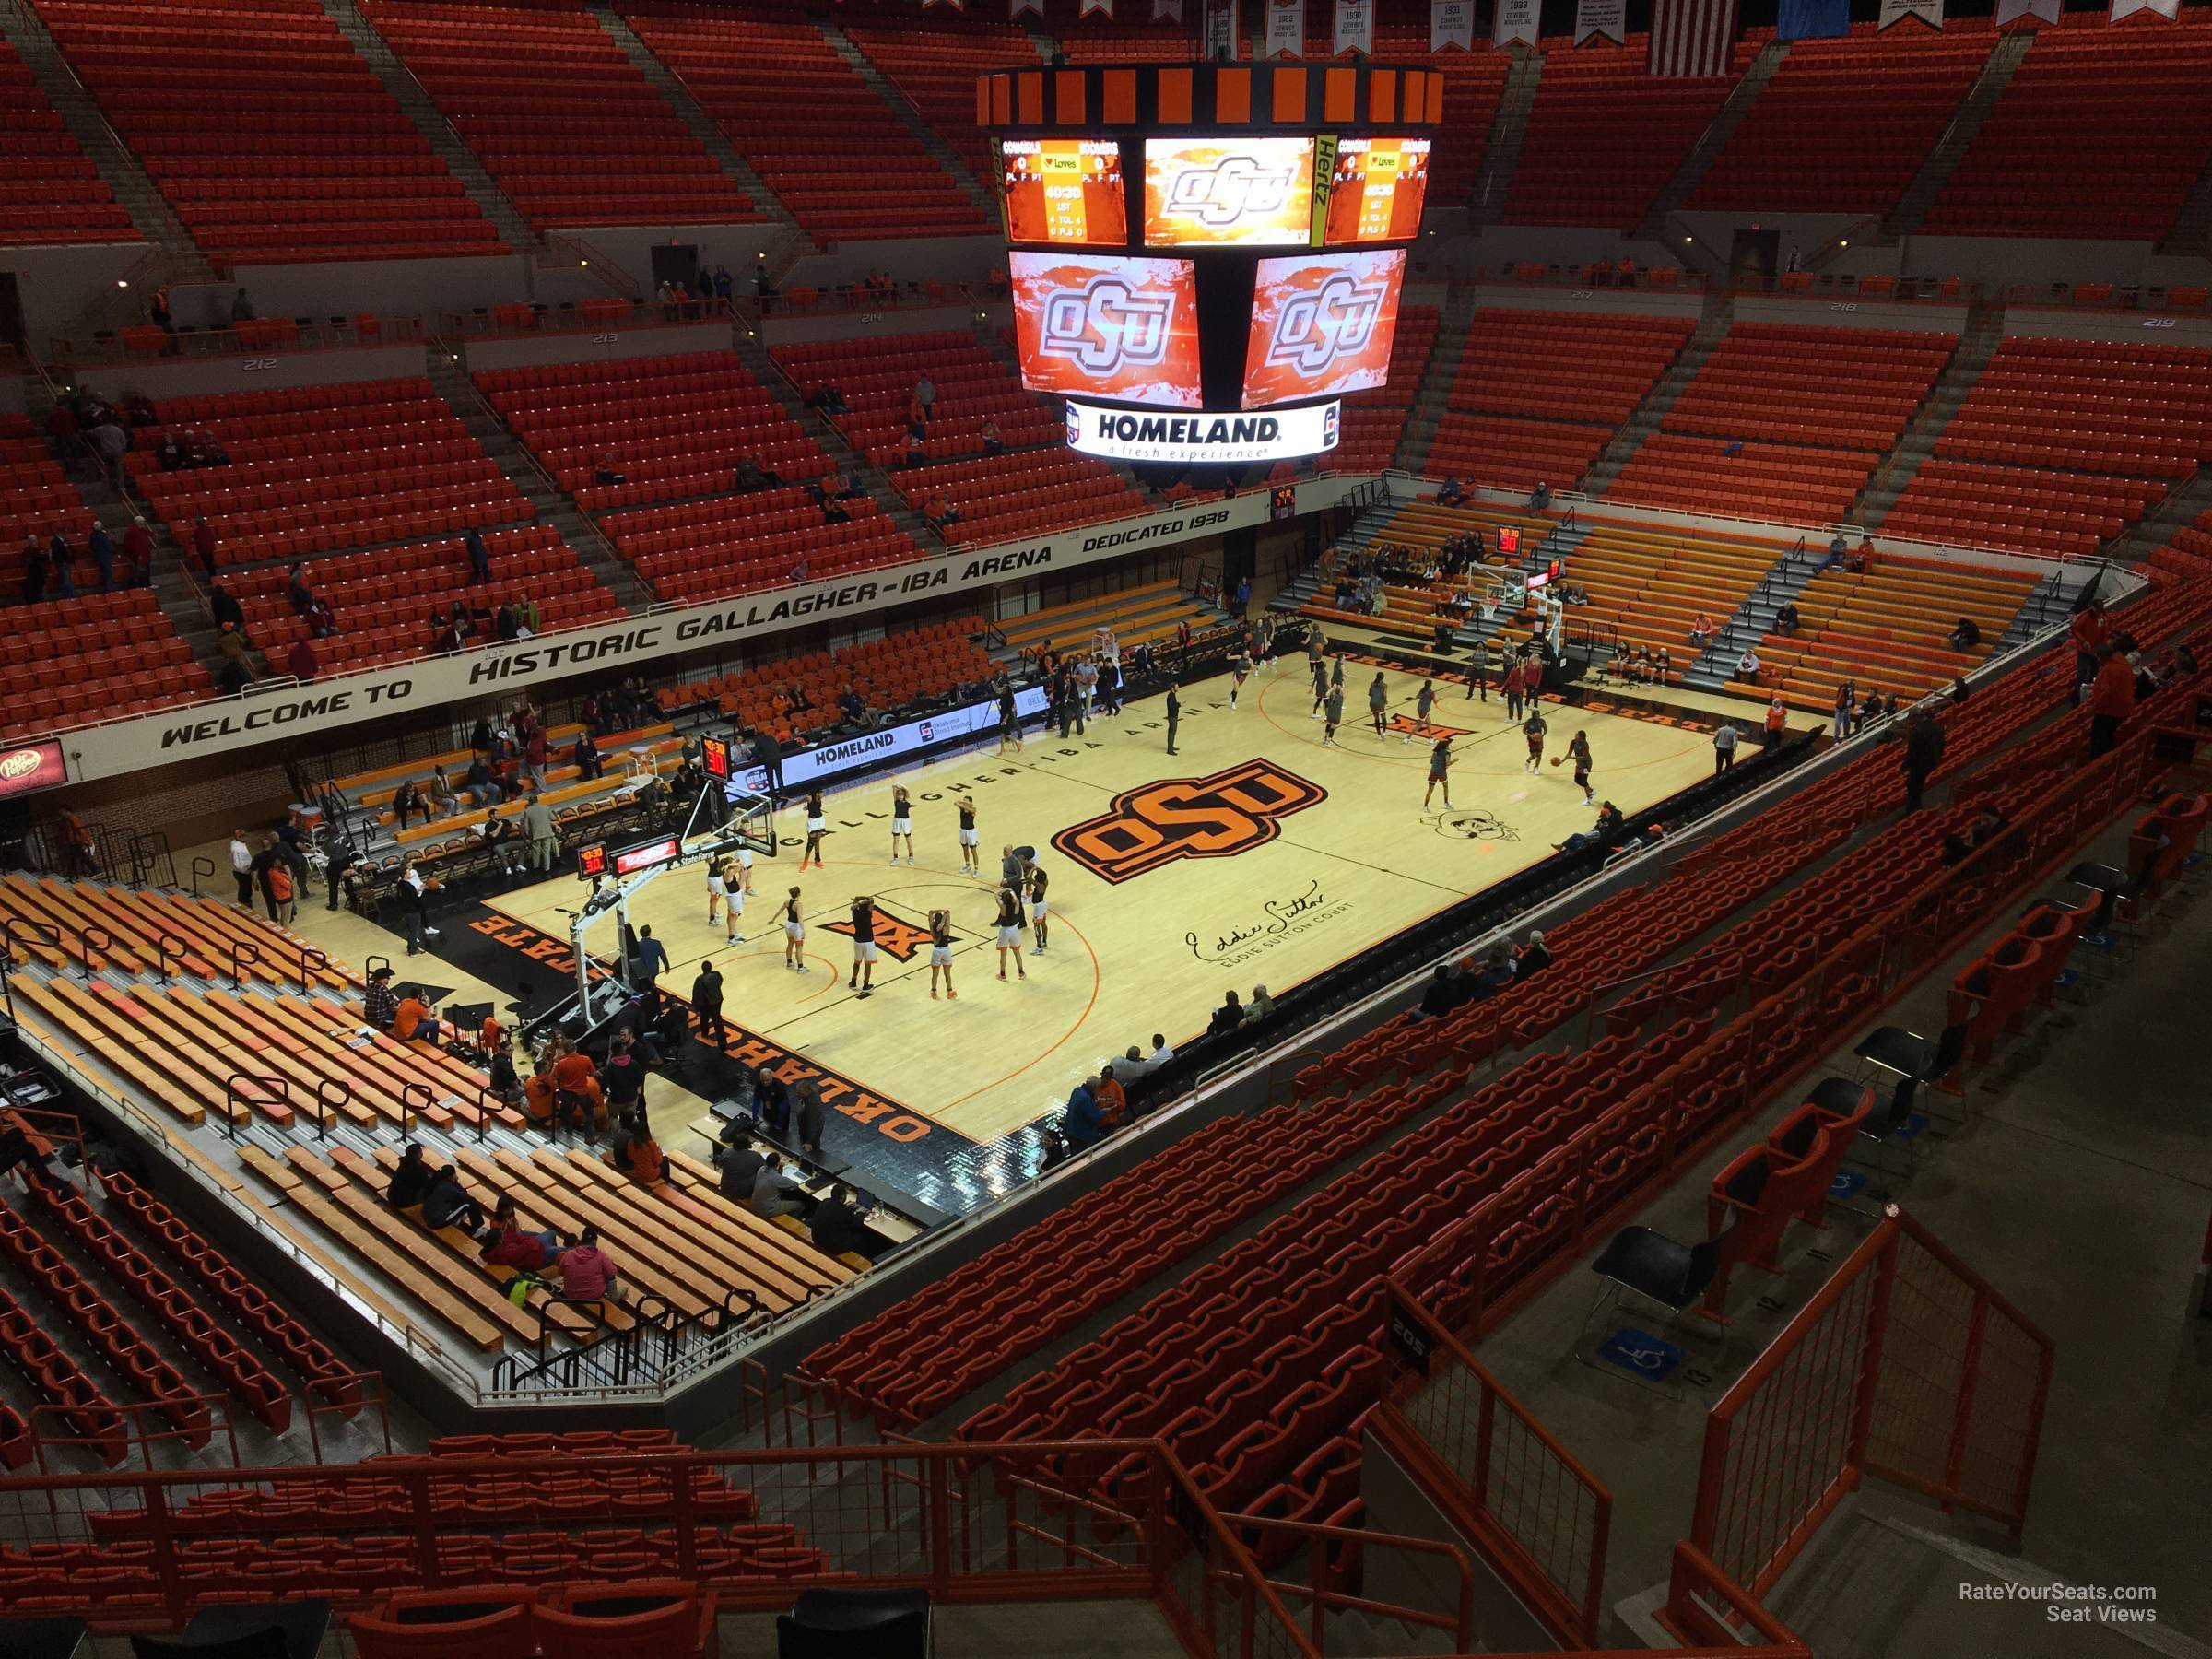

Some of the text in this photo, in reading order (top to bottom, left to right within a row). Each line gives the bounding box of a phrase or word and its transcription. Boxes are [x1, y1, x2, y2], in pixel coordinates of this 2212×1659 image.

[1506, 11, 1530, 19] COWBOY
[1510, 1, 1528, 10] 1933
[1020, 172, 1027, 182] F
[1031, 173, 1042, 182] PT
[1097, 173, 1103, 182] F
[1315, 139, 1335, 206] Hertz
[1160, 156, 1298, 227] OSU
[861, 313, 883, 323] 214
[1039, 275, 1177, 378] OSU
[1264, 272, 1389, 377] OSU
[2143, 317, 2176, 328] 219
[592, 332, 619, 345] 213
[242, 359, 277, 371] 212
[1122, 446, 1159, 458] fresh
[1500, 536, 1516, 553] 30
[161, 690, 353, 749] WELCOME
[364, 679, 413, 704] TO
[468, 626, 662, 685] HISTORIC
[961, 546, 1053, 581] ARENA
[1082, 519, 1184, 553] DEDICATED
[1188, 510, 1230, 530] 1938
[1583, 701, 1747, 735] STAT
[5, 754, 40, 778] Pepper
[707, 751, 725, 775] 30
[1051, 757, 1328, 886] OSU
[1185, 924, 1262, 962] Eddie
[1219, 901, 1356, 969] EDDIE SUTTON COURT
[1757, 1295, 1785, 1313] 12
[1392, 1317, 1426, 1357] 205
[1683, 1369, 1712, 1386] 13
